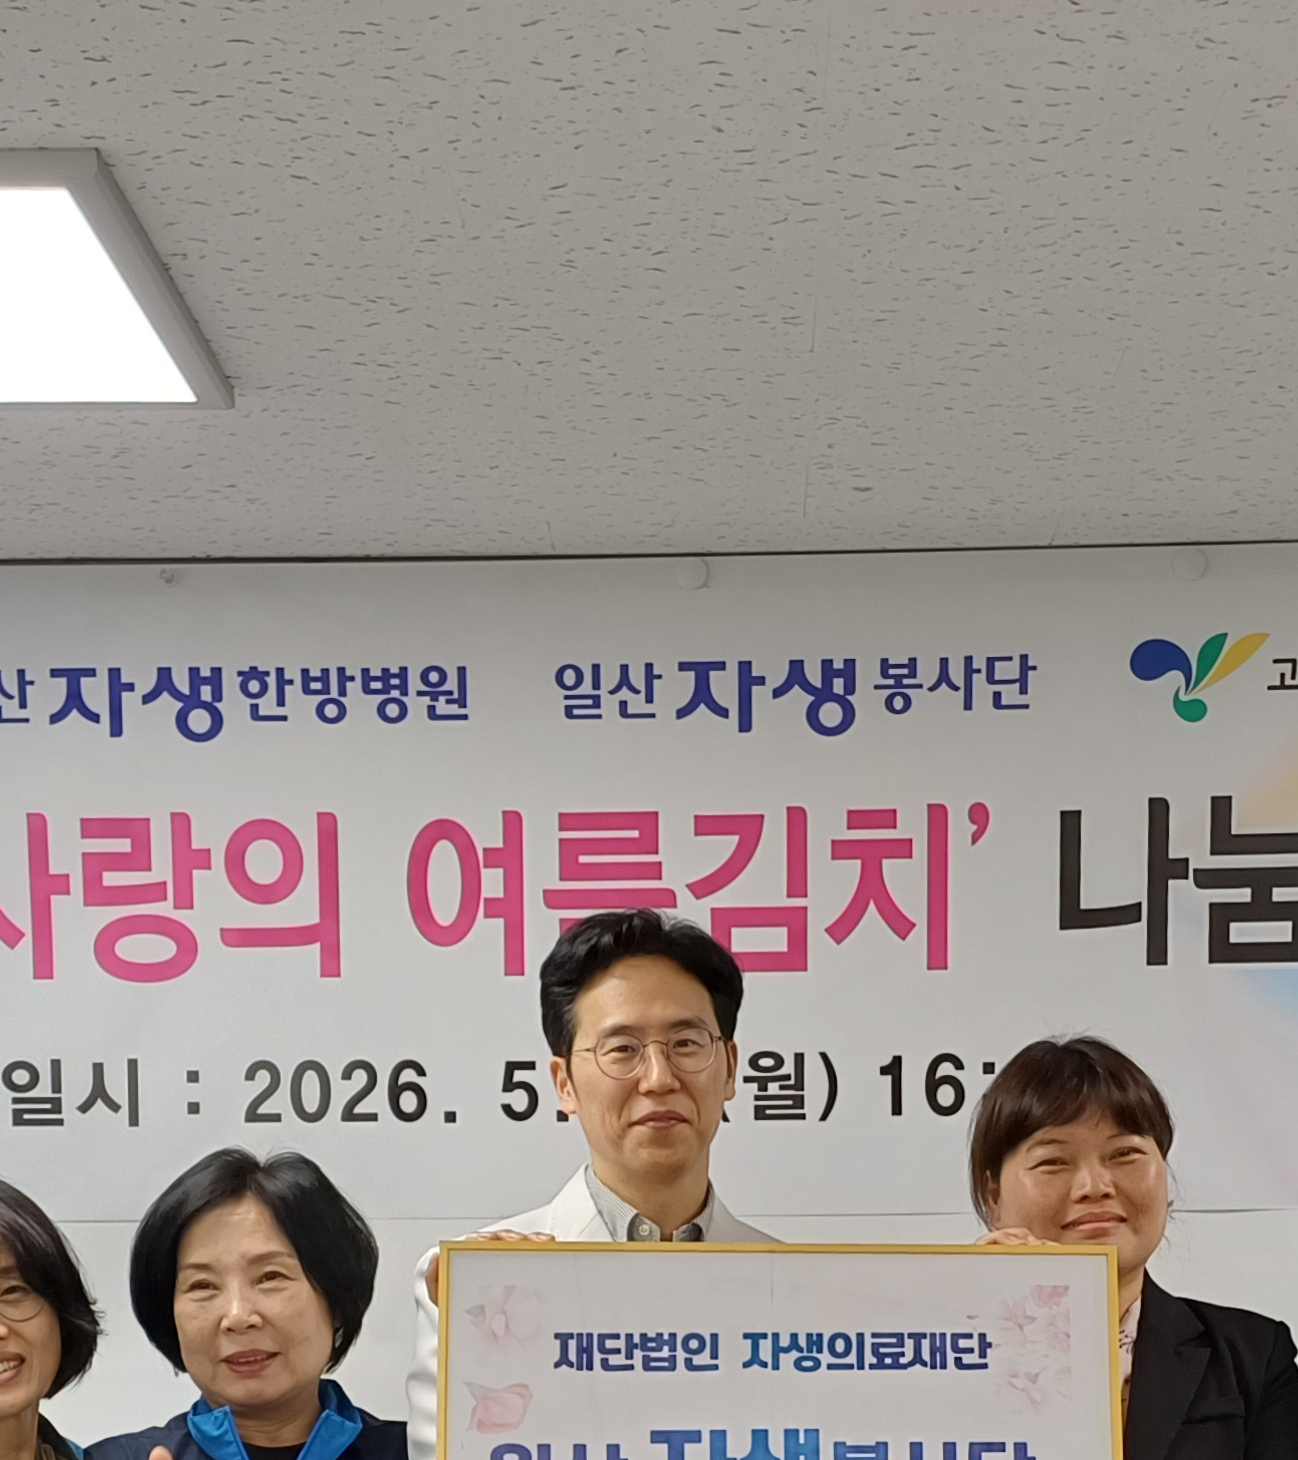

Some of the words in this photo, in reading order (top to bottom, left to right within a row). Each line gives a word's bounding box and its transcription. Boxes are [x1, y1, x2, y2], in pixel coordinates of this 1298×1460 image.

[1, 1058, 140, 1127] 일시
[243, 1059, 458, 1124] 2026.
[553, 1331, 720, 1372] 재단법인
[742, 1331, 993, 1372] 자생의료재단
